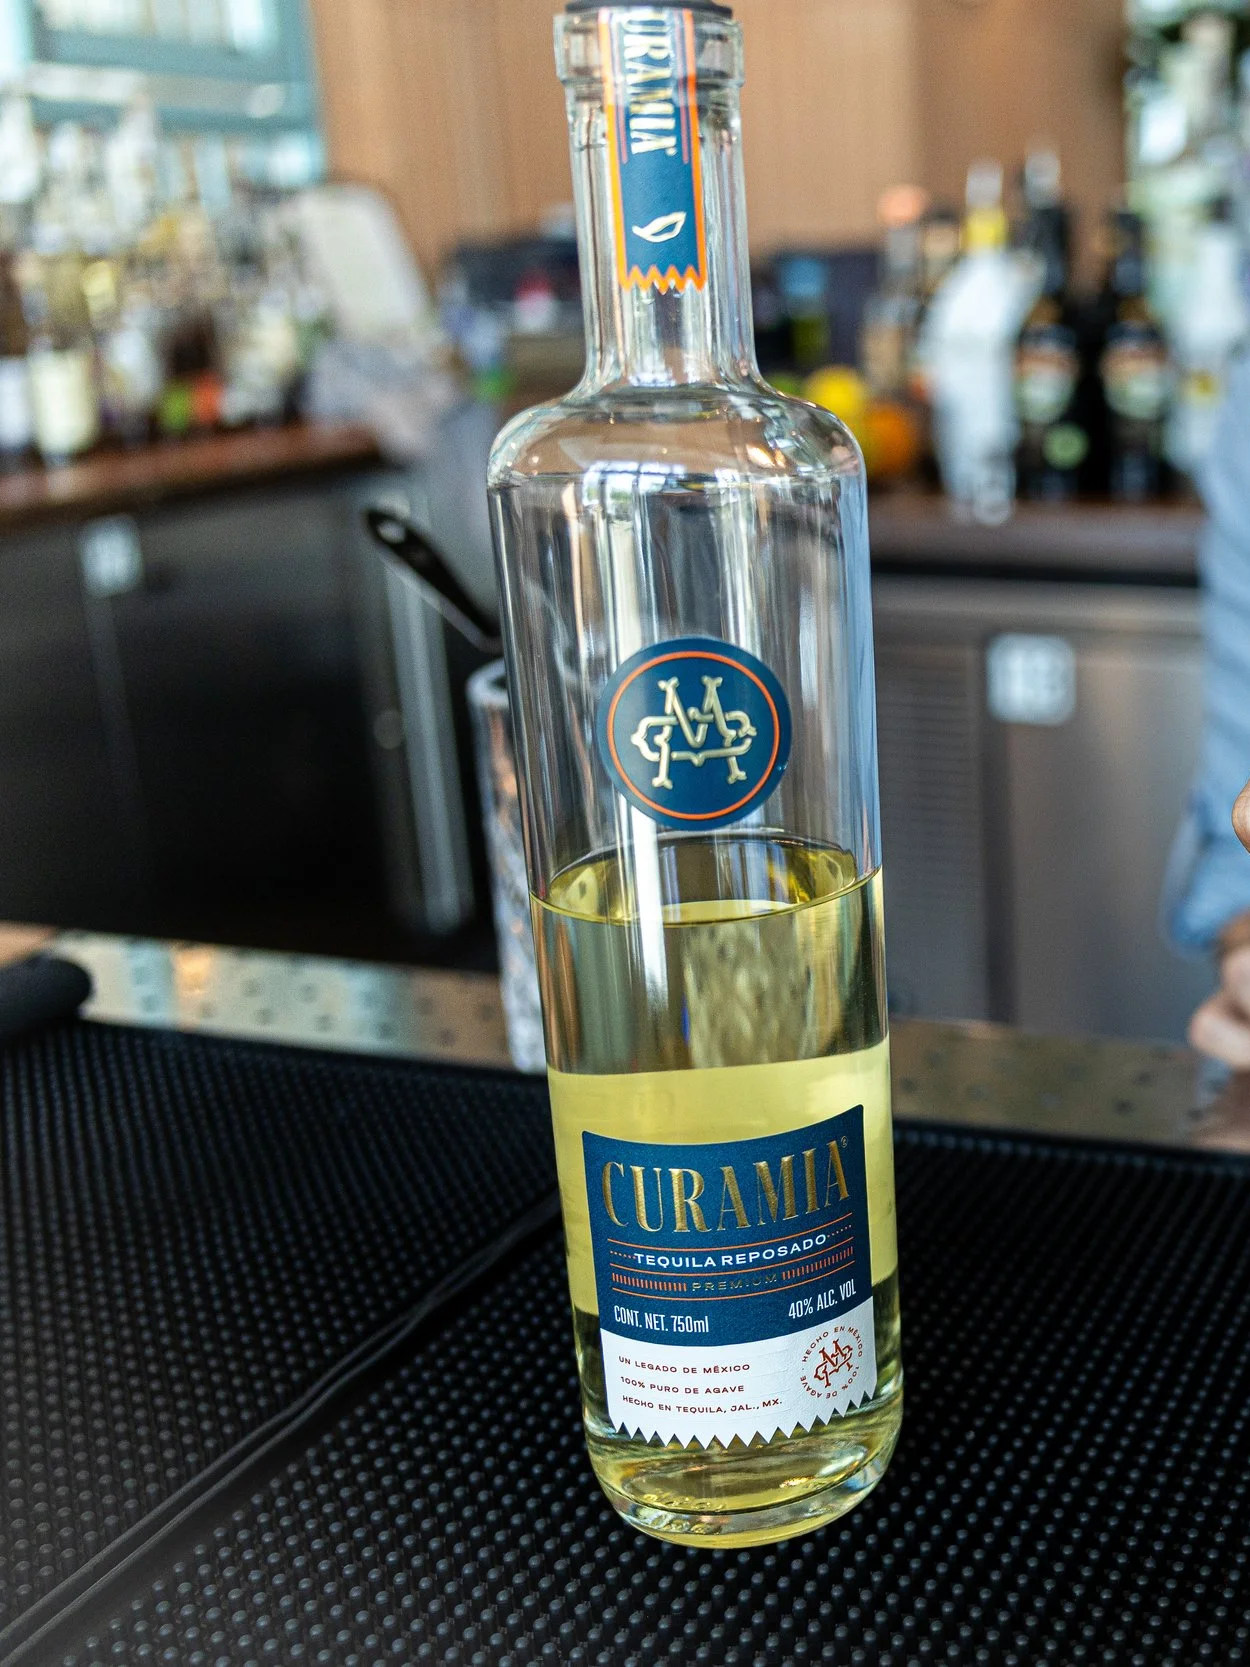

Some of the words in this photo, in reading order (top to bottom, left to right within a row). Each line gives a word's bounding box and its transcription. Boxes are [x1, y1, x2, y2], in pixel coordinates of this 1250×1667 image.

[634, 1252, 716, 1269] TEQUILA
[721, 1233, 827, 1266] REPOSADO
[691, 1273, 777, 1292] PREMIUM
[788, 1296, 814, 1320] 40%
[816, 1288, 838, 1312] ALC.
[839, 1278, 857, 1301] VOL
[613, 1304, 643, 1328] CONT.
[644, 1312, 669, 1332] NET.
[670, 1315, 709, 1333] 750ml
[801, 1330, 829, 1363] HECHO
[833, 1326, 846, 1334] EN
[618, 1355, 632, 1366] UN
[634, 1360, 678, 1374] LEGADO
[682, 1366, 698, 1375] DE
[703, 1363, 751, 1374] MÉXICO
[620, 1375, 646, 1390] 100%
[649, 1383, 680, 1394] PURO
[684, 1386, 700, 1395] DE
[704, 1384, 745, 1395] AGAVE
[622, 1395, 655, 1410] HECHO
[658, 1403, 672, 1412] EN
[675, 1405, 727, 1414] TEQUILA,
[730, 1403, 760, 1413] JAL.,
[762, 1397, 783, 1408] MX.
